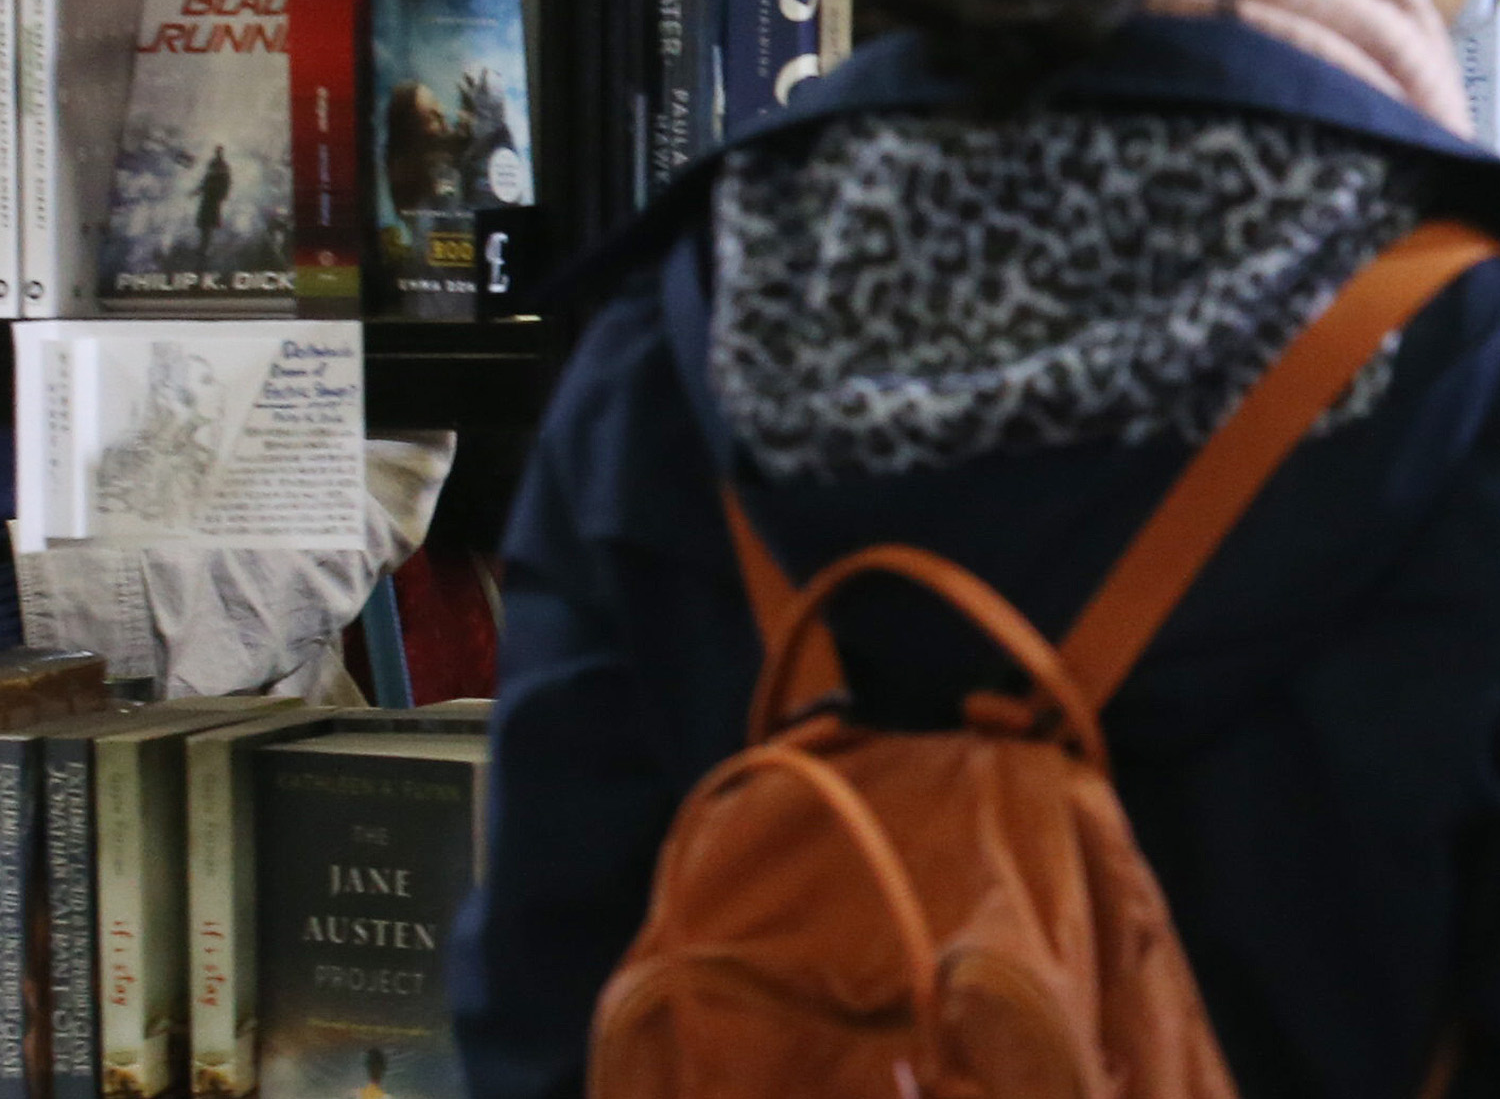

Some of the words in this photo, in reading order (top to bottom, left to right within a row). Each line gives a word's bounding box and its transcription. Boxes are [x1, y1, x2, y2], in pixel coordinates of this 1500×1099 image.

[670, 87, 691, 165] PAULA
[116, 272, 198, 291] PHILIP
[200, 272, 228, 291] K.
[231, 271, 298, 291] DICK
[328, 863, 413, 898] JANE
[302, 914, 436, 951] AUSTEN
[315, 963, 426, 996] PROJECT
